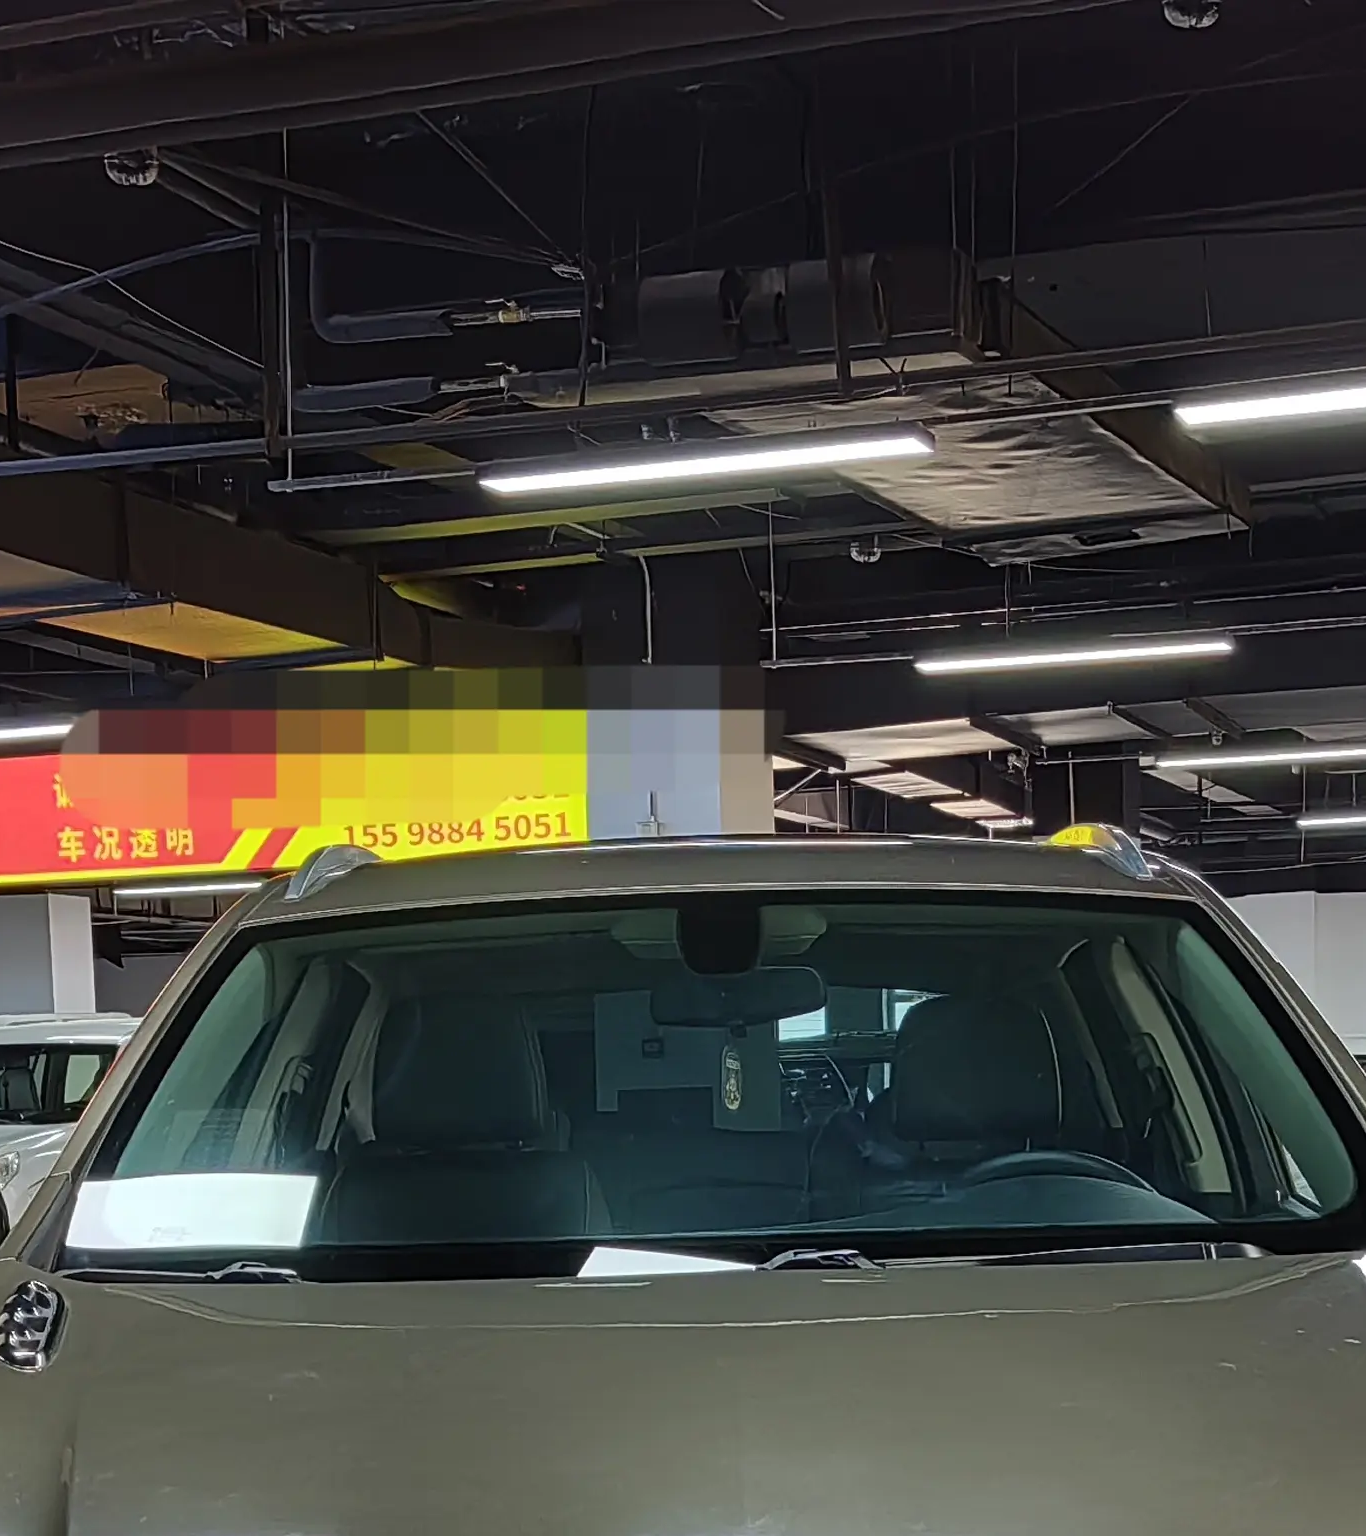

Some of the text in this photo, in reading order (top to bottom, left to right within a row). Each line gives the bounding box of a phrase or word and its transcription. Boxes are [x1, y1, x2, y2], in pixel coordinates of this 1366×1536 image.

[56, 825, 195, 863] 车况透明
[344, 811, 572, 848] 155 9884 5051
